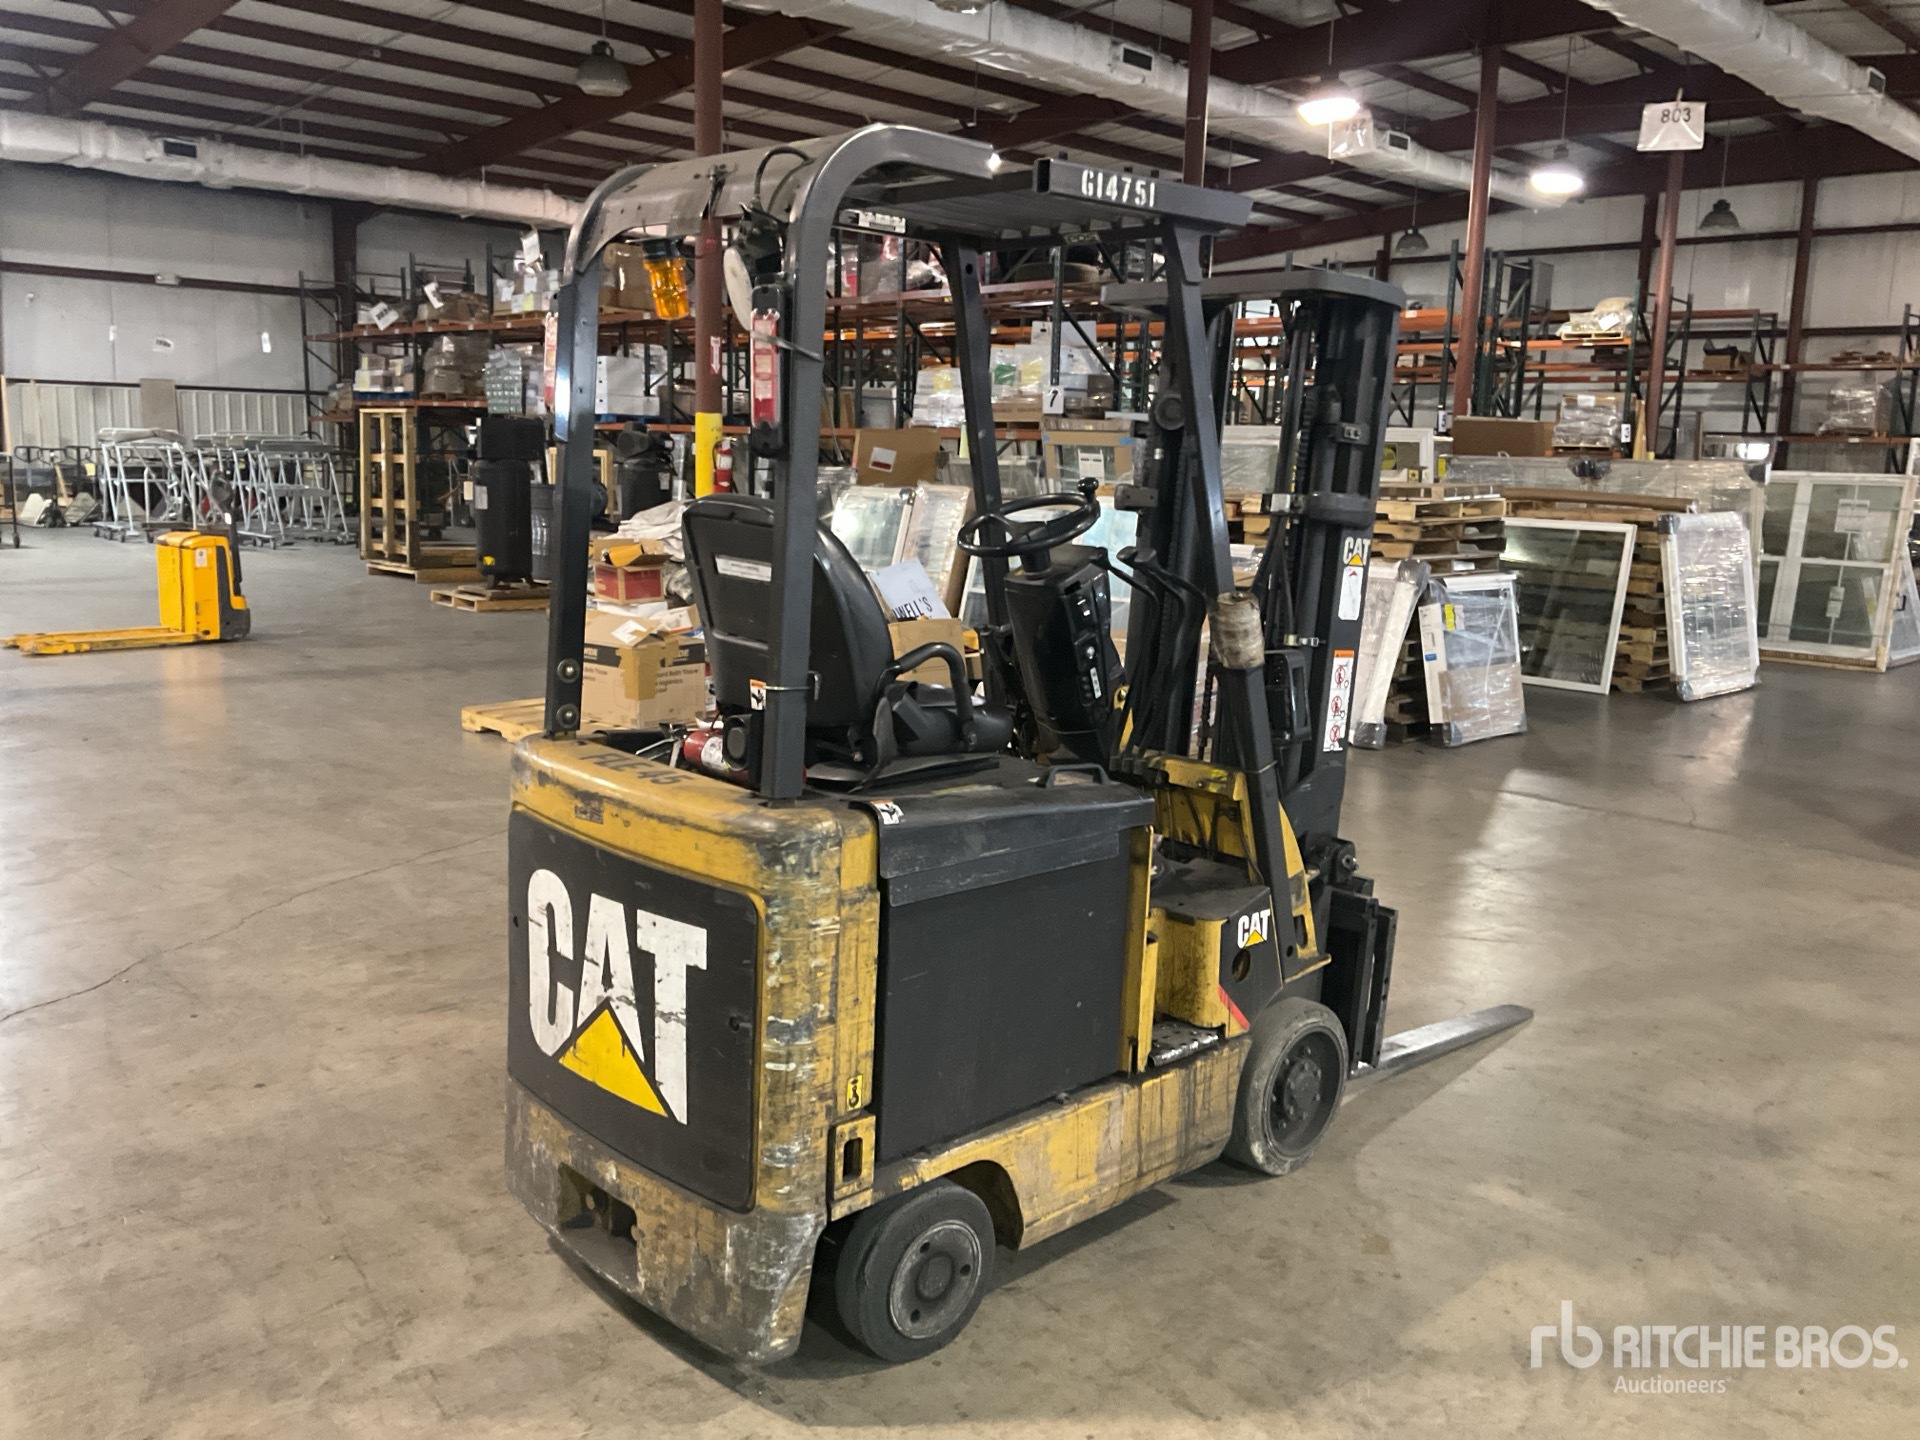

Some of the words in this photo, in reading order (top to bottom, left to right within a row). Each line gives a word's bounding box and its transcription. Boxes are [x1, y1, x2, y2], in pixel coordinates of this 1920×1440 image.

[1660, 107, 1691, 124] 803
[1081, 169, 1156, 208] G14751
[1049, 389, 1059, 408] 7
[1342, 536, 1371, 566] CAT
[1237, 908, 1271, 949] CAT
[527, 868, 708, 1126] CAT
